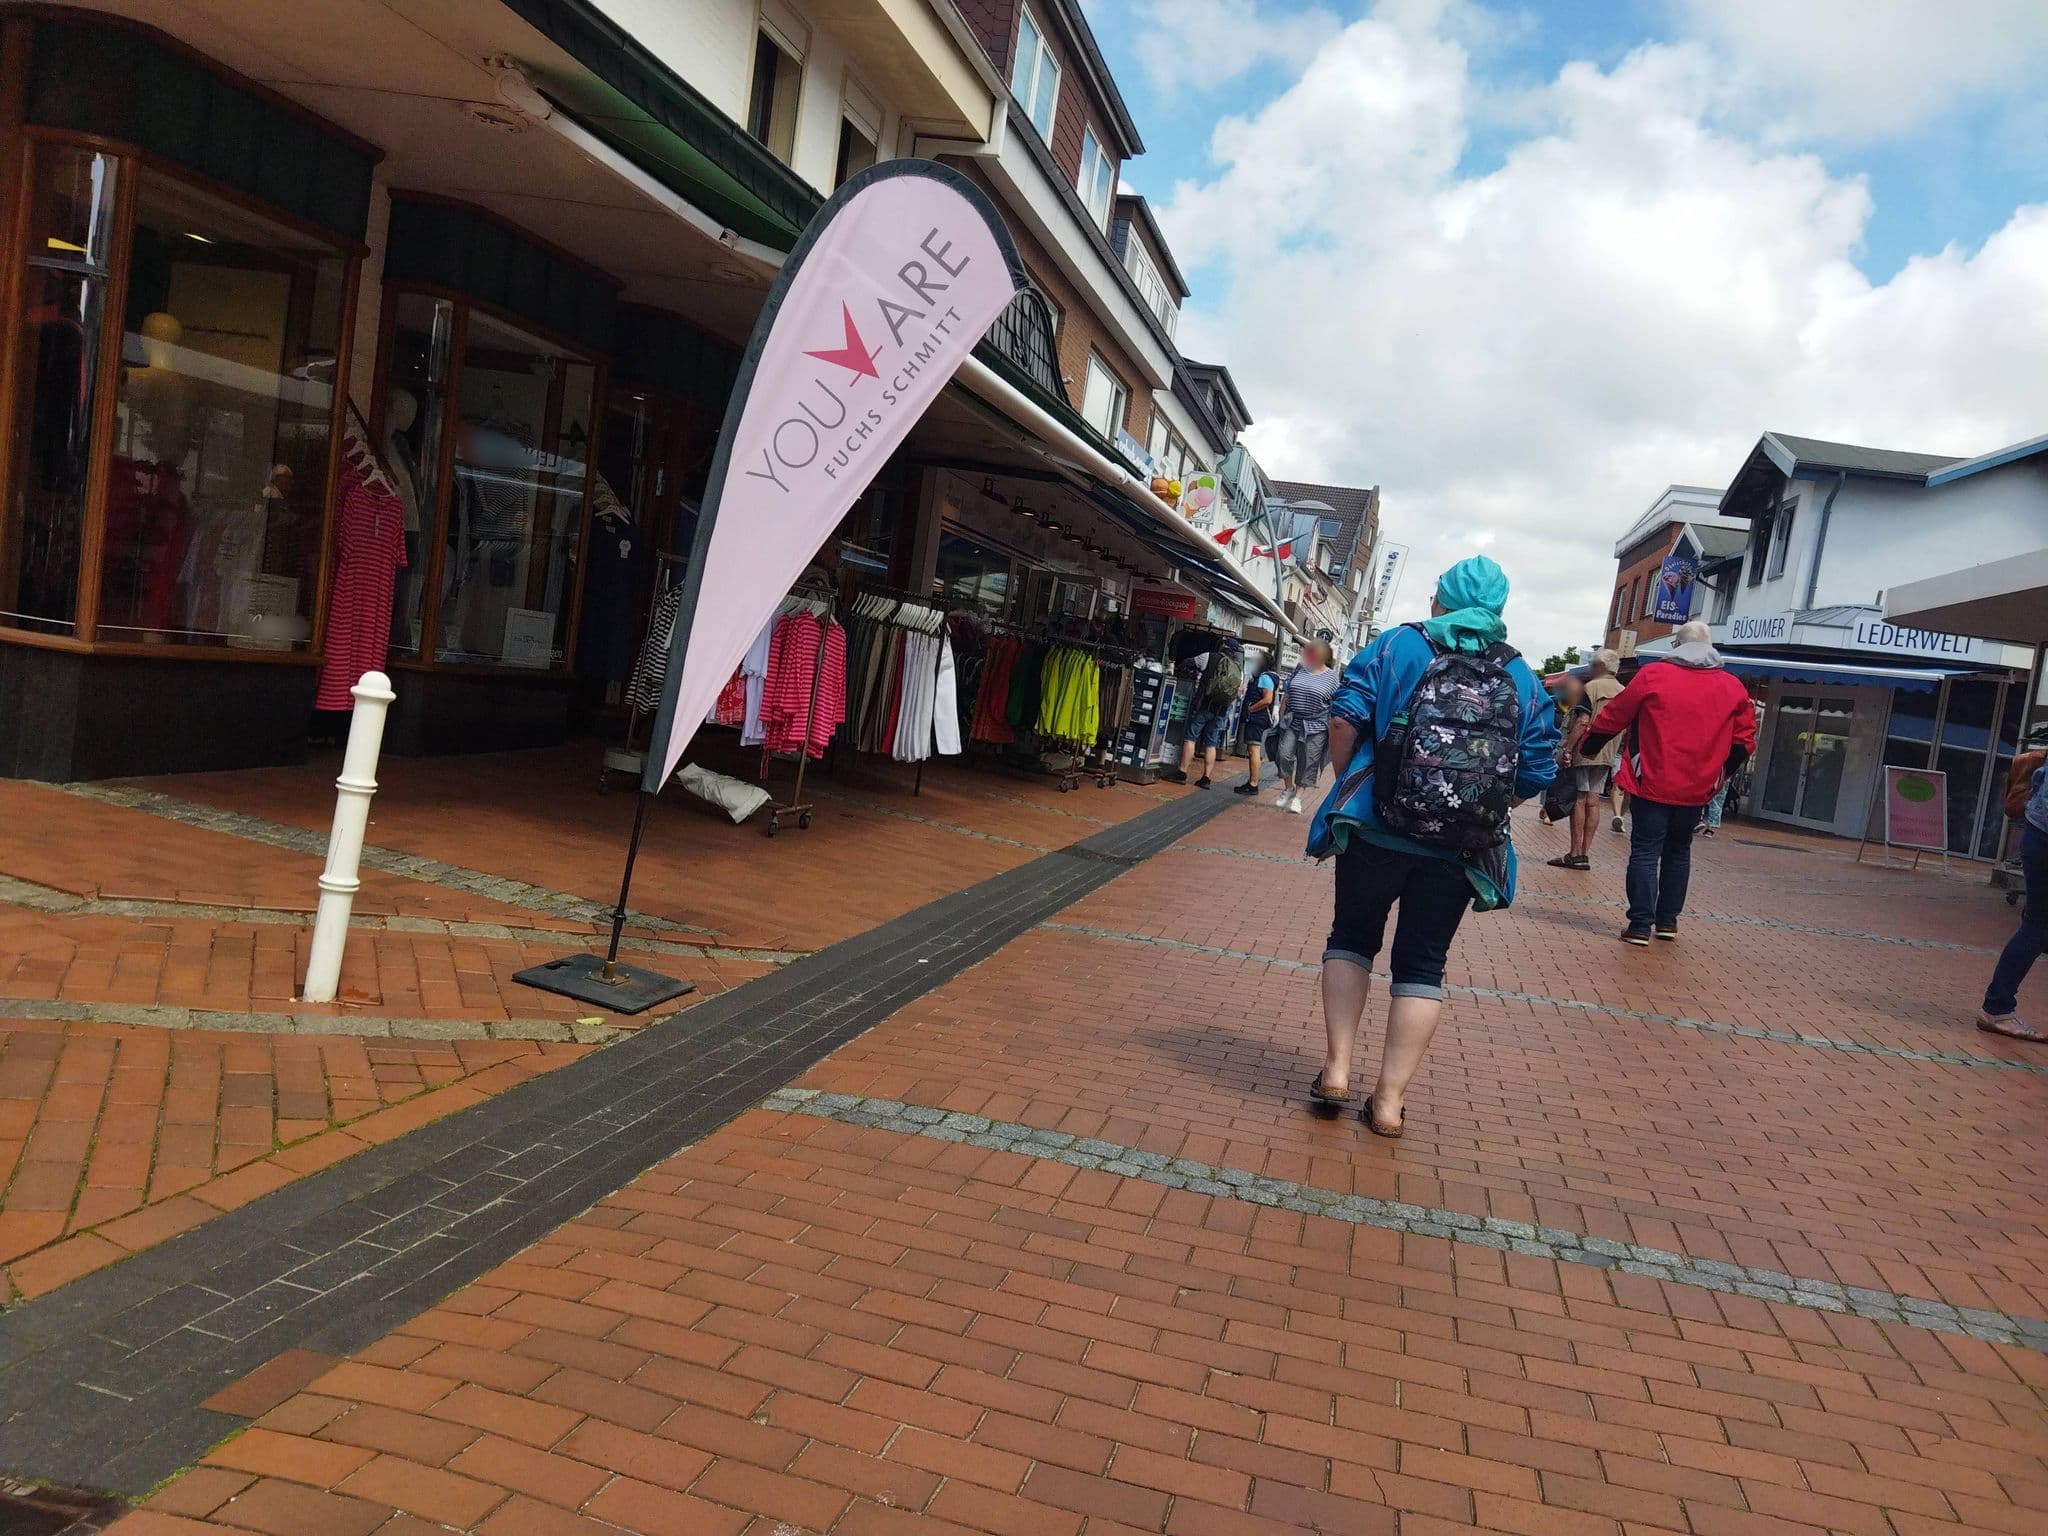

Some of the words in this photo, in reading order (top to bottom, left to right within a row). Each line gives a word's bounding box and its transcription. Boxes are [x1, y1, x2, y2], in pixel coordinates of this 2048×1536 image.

[745, 379, 846, 493] YOU
[877, 227, 970, 347] ARE
[824, 409, 882, 479] FUCHS
[883, 306, 962, 405] SCHMITT
[1732, 616, 1786, 639] BÜSUMER
